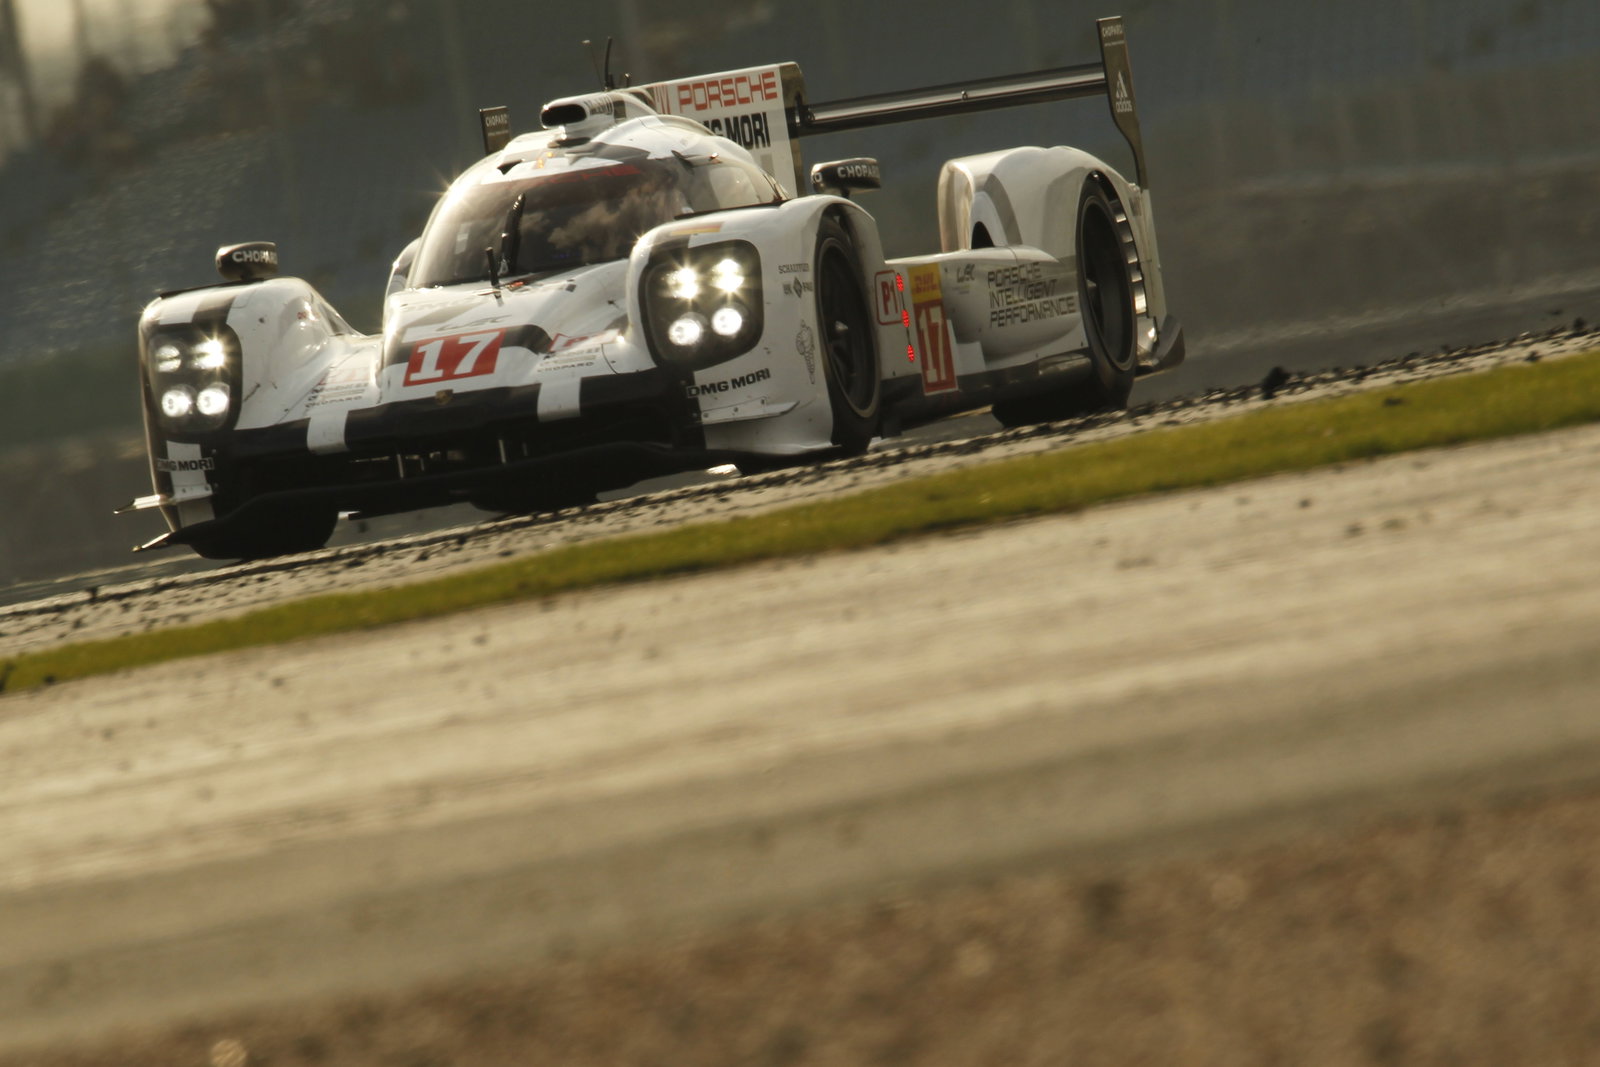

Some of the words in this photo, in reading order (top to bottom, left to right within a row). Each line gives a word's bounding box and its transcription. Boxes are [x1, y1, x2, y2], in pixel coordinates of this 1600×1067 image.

[677, 71, 778, 114] PORSCHE
[724, 111, 771, 150] MORI
[988, 261, 1041, 288] PORSCHE
[989, 279, 1057, 309] INTELLIGENT
[990, 296, 1077, 328] PERFORMANCE
[409, 331, 501, 381] 17
[919, 305, 947, 383] 17
[687, 381, 730, 397] DMG
[731, 368, 771, 389] MORI
[178, 459, 213, 471] MORI
